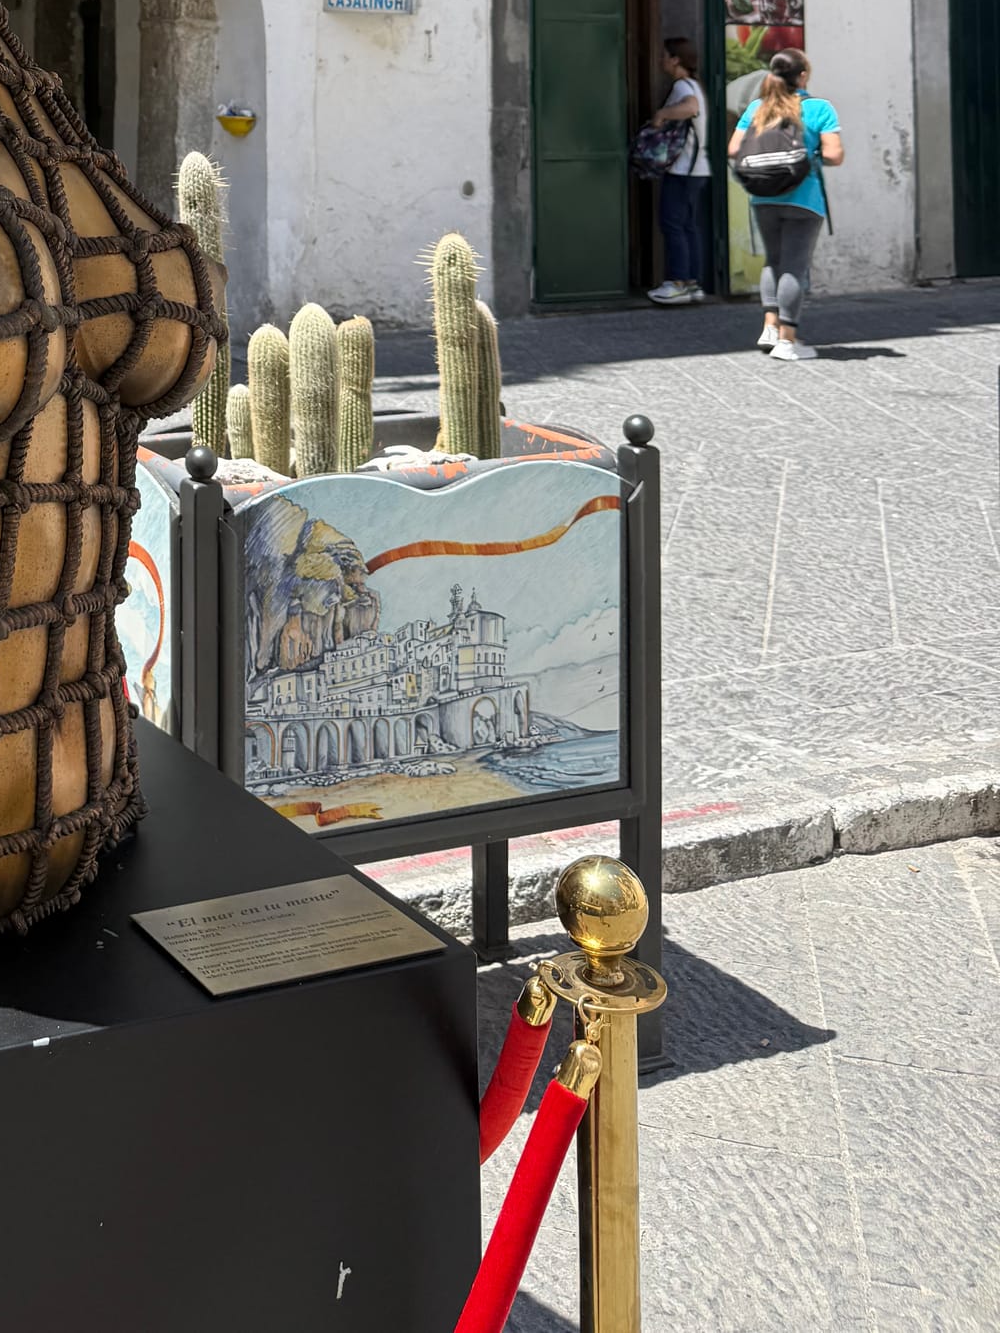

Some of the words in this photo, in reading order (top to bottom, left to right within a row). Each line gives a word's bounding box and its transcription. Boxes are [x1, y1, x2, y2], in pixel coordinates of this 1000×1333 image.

[203, 912, 235, 924] mar
[241, 906, 260, 916] en
[265, 902, 281, 912] tu
